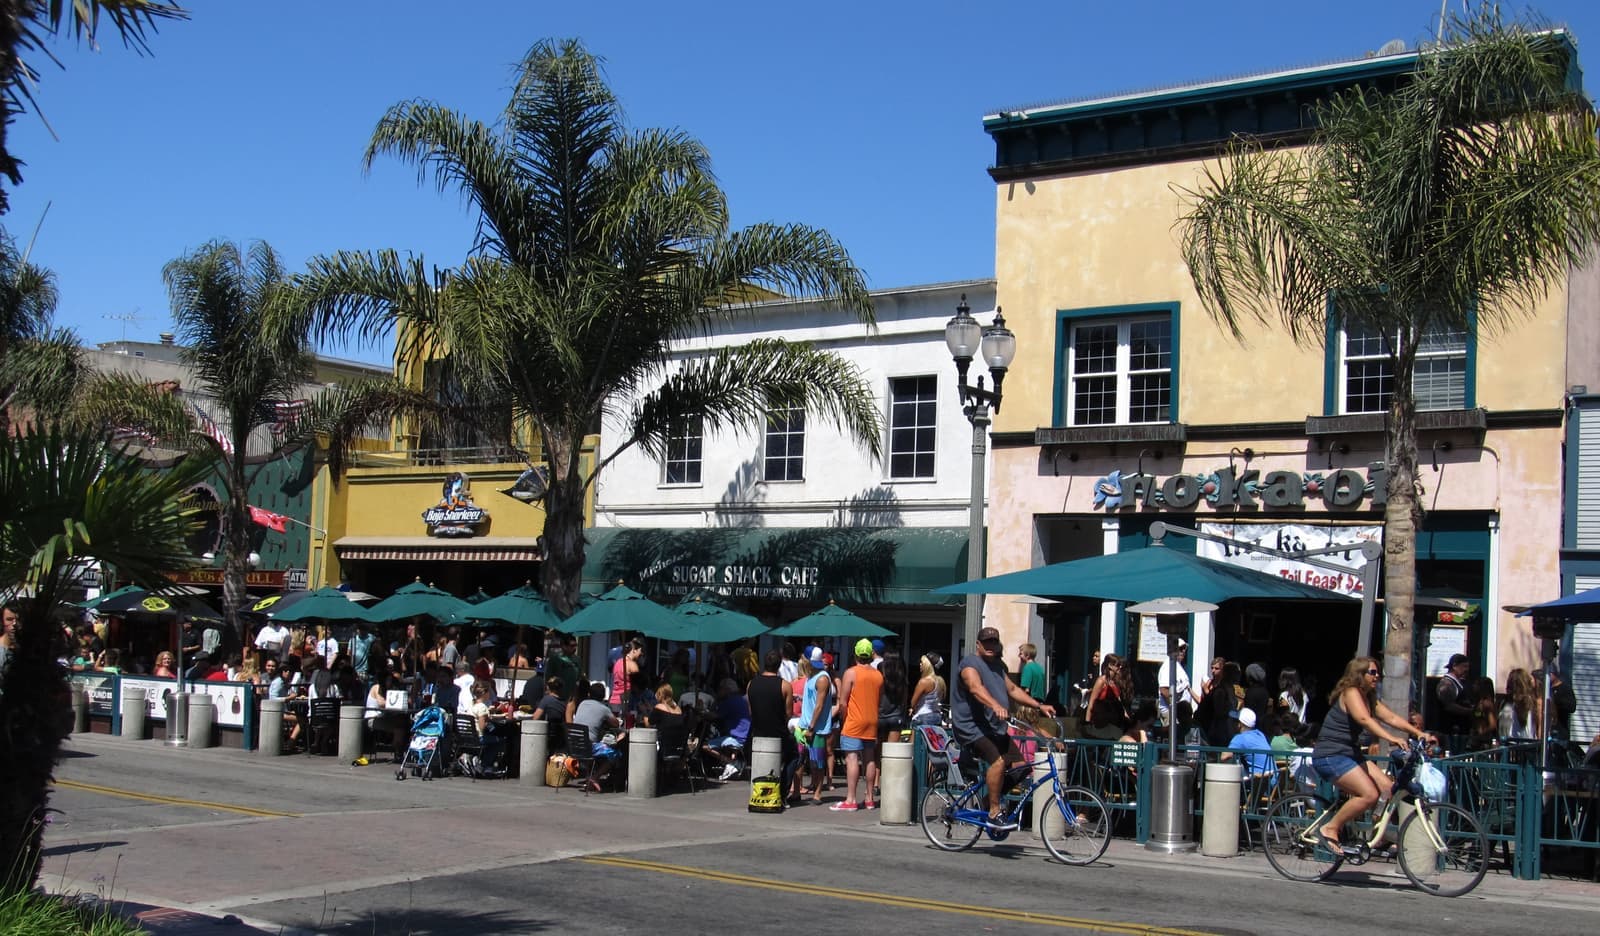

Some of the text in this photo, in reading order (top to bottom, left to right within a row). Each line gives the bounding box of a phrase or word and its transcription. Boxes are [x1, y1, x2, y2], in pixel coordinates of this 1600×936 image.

[426, 510, 444, 523] Baja
[290, 572, 307, 582] ATM
[671, 565, 818, 586] SUGAR SHACK CAFE
[1280, 569, 1301, 582] Tail
[1305, 570, 1342, 591] Feast
[795, 587, 811, 599] 1967
